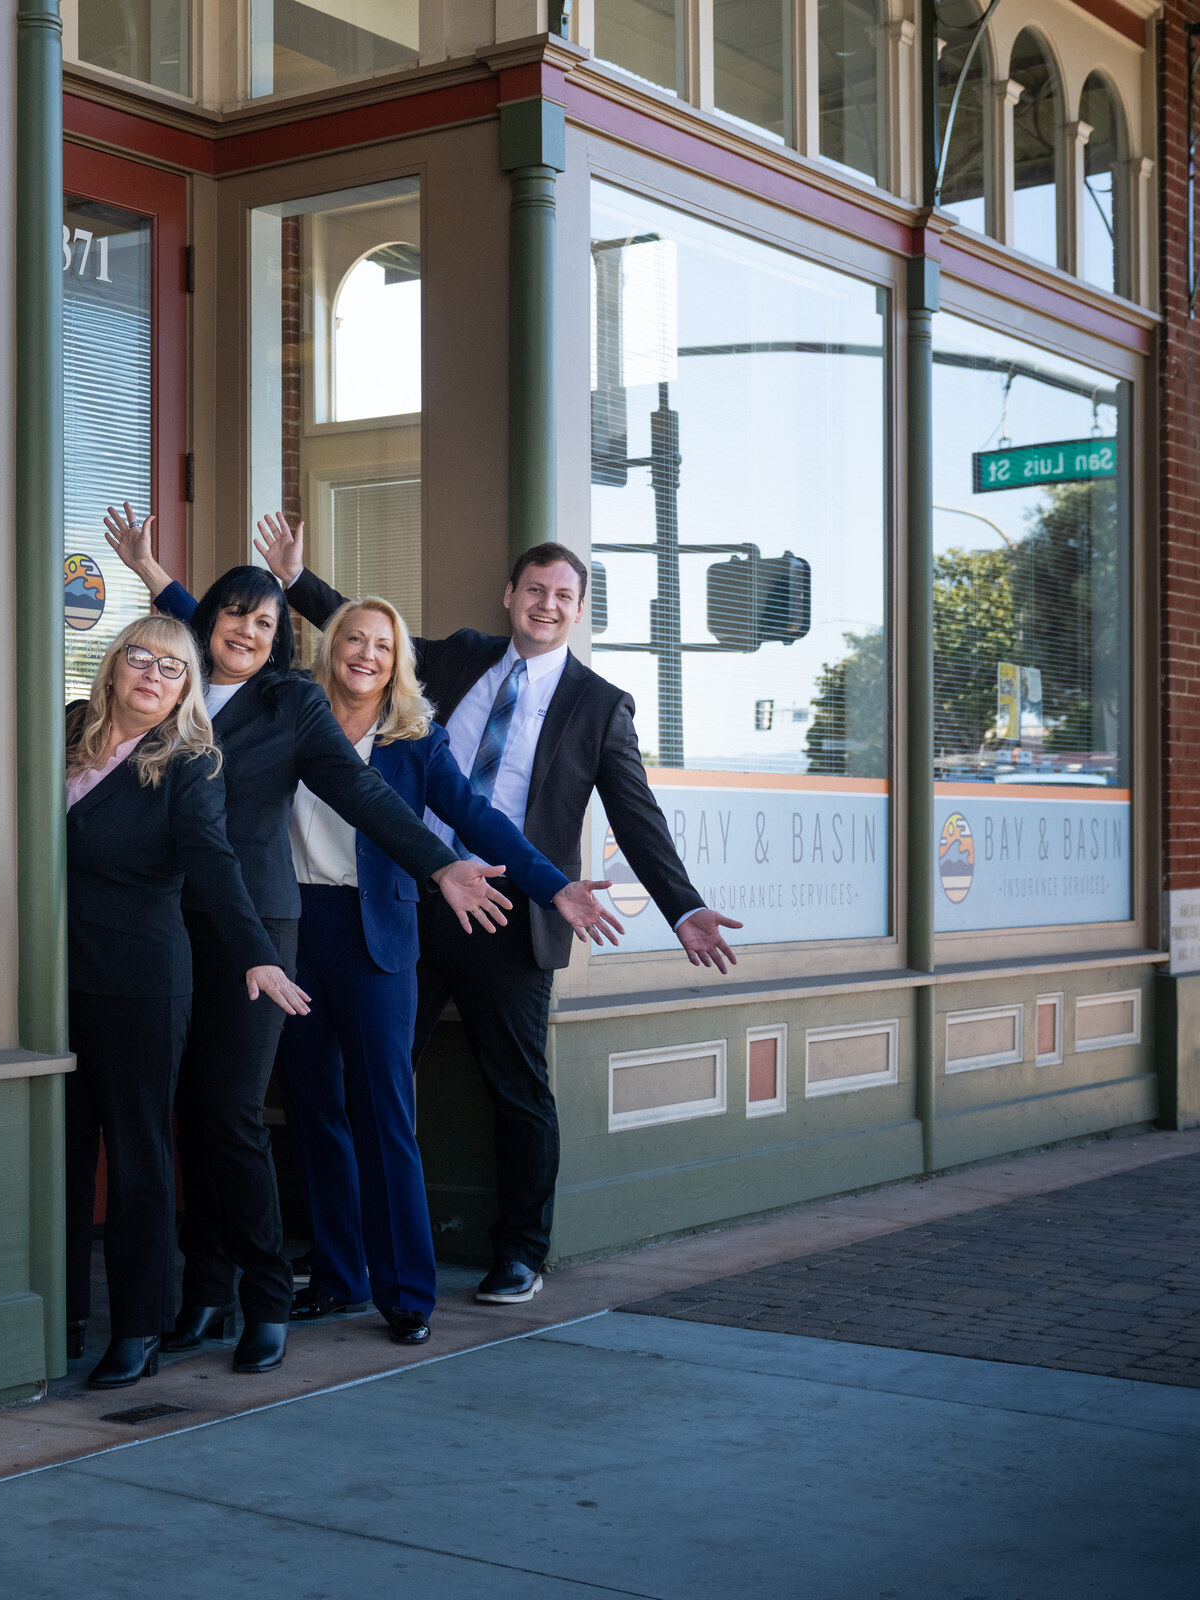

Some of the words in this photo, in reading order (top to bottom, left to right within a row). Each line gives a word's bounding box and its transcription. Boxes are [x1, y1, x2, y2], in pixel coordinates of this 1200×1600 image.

[674, 809, 731, 864] BAY
[754, 811, 769, 865] &
[792, 812, 876, 864] BASIN
[985, 816, 1023, 861] BAY
[1039, 817, 1049, 861] &
[1064, 818, 1122, 860] BASIN
[703, 884, 783, 909] INSURANCE
[791, 883, 853, 907] SERVICES
